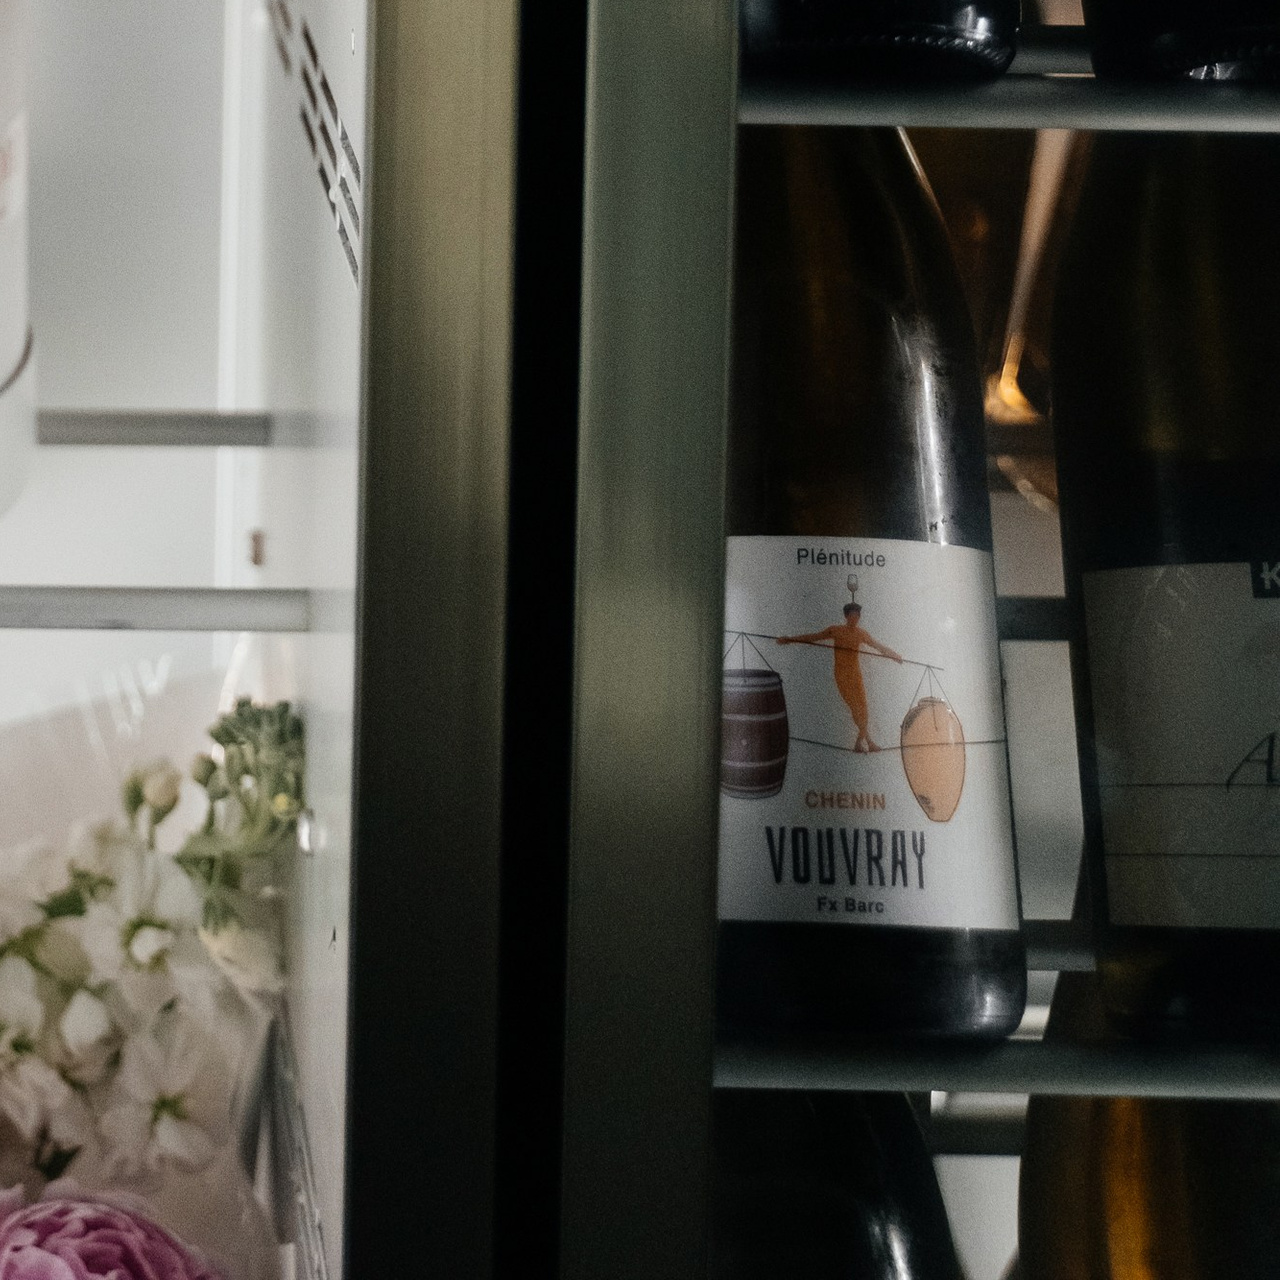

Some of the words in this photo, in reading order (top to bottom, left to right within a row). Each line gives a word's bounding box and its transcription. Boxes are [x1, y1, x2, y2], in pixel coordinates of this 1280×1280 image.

[796, 547, 887, 568] Plénitude
[805, 790, 887, 811] CHENIN
[765, 824, 927, 890] VOUVRAY
[818, 897, 838, 914] Fx
[844, 897, 885, 915] Barc
